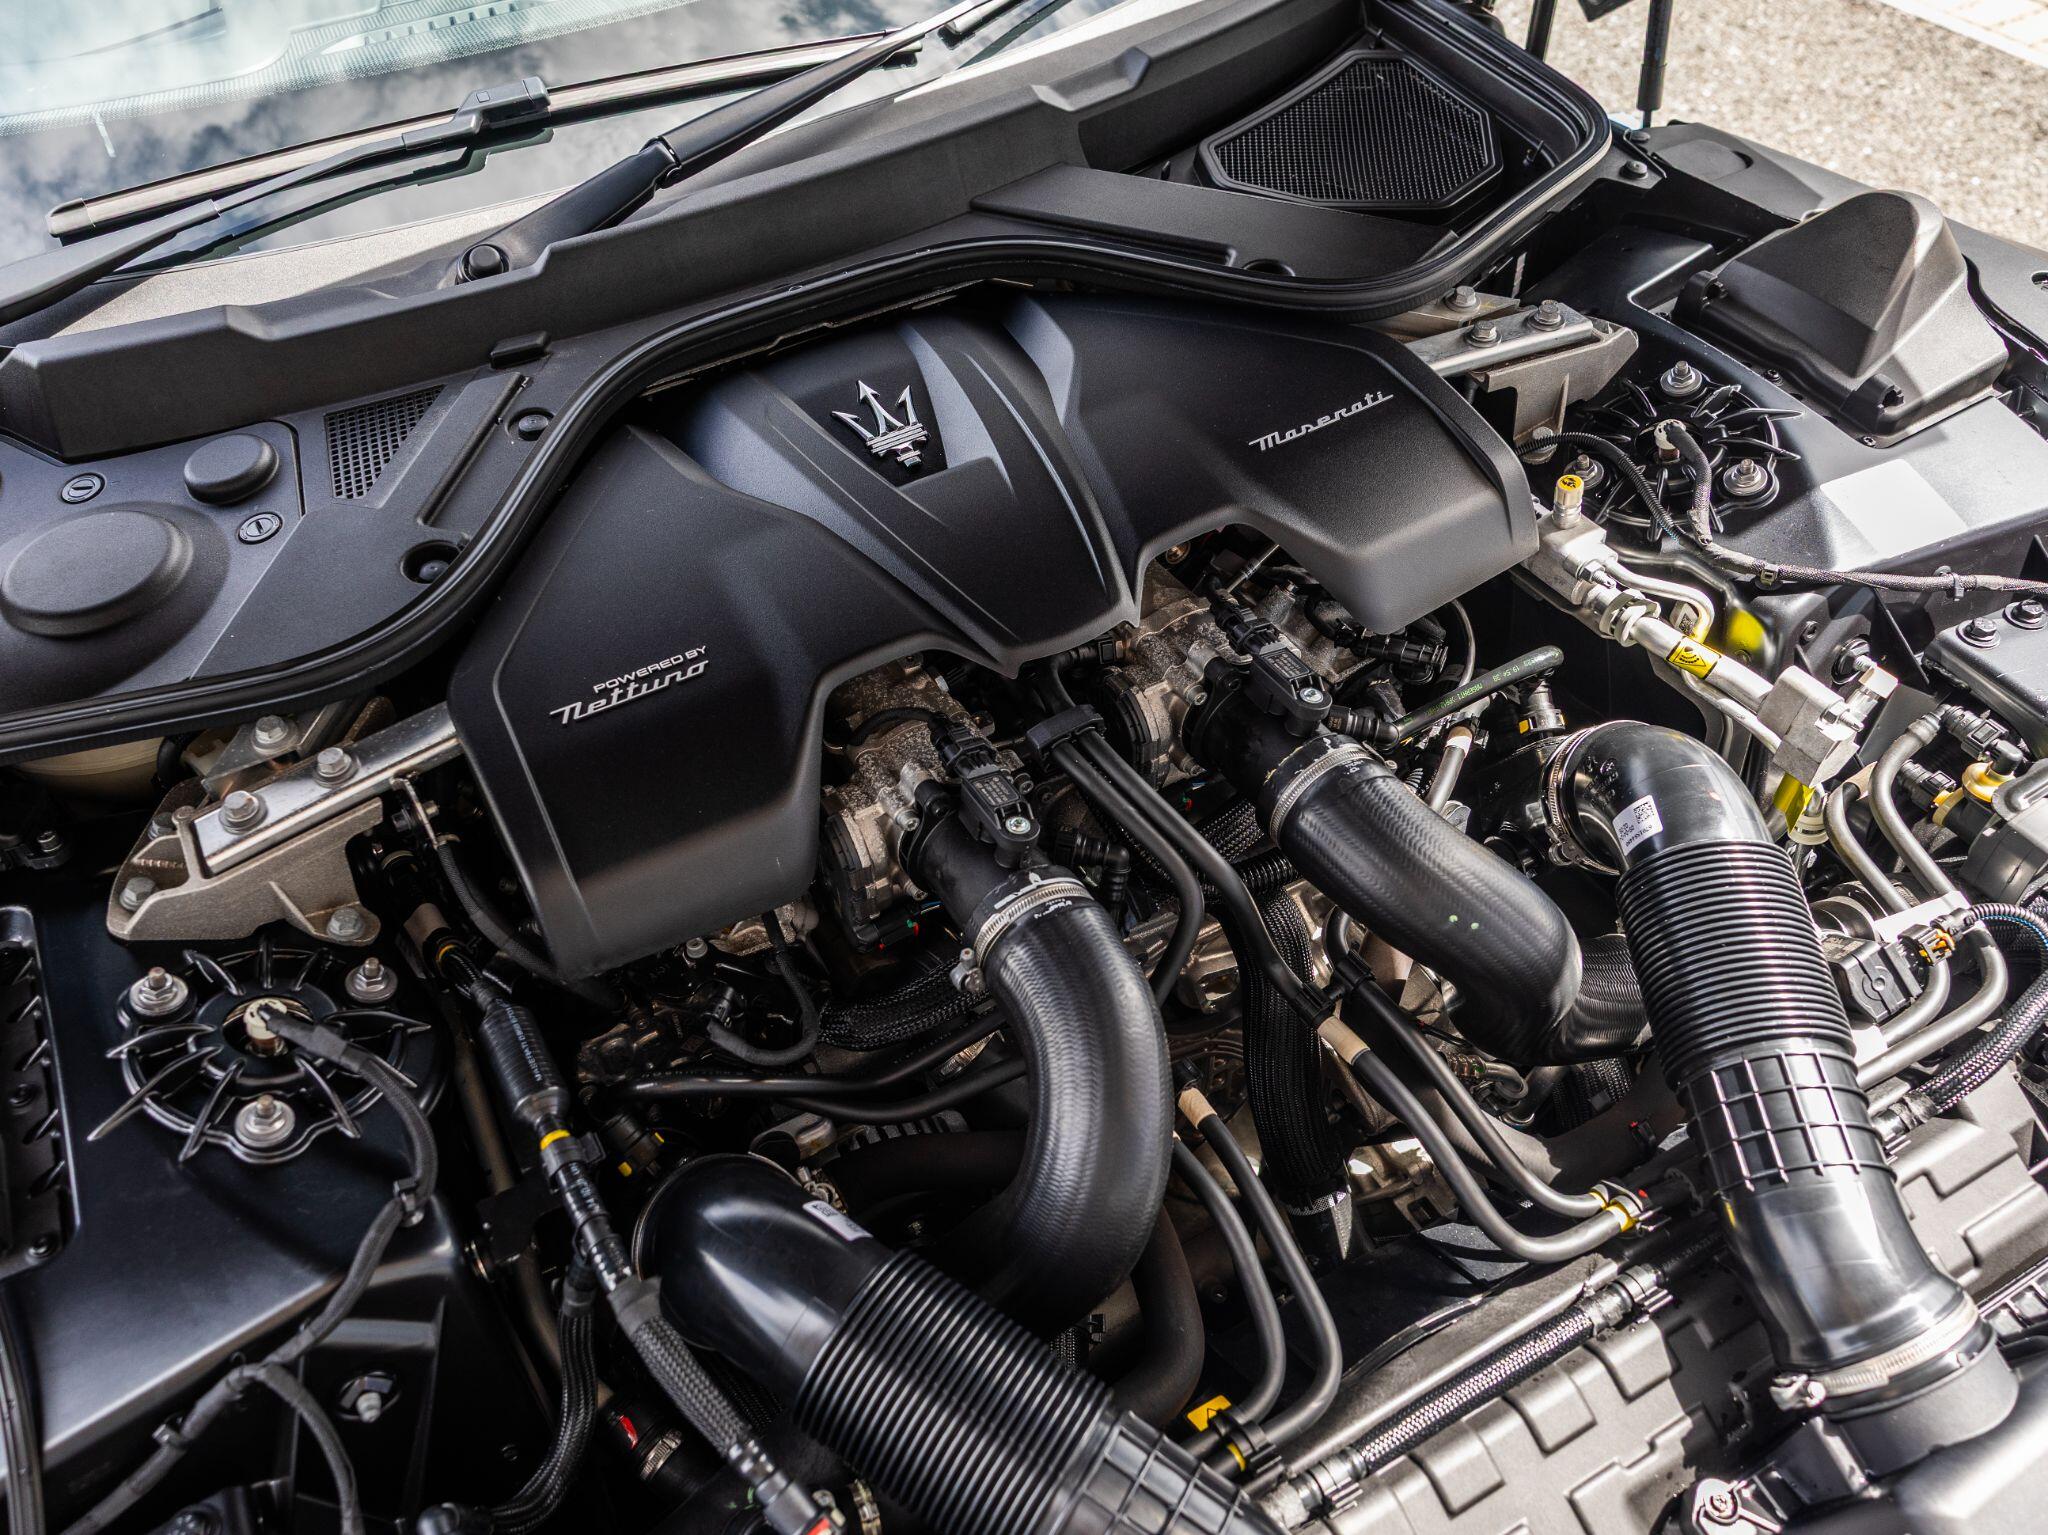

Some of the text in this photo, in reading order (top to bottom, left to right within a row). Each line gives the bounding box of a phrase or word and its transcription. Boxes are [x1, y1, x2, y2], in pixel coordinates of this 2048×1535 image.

[1248, 391, 1394, 451] Maserati
[549, 660, 709, 724] Nettuno
[593, 645, 706, 693] POWERED BY
[520, 1040, 542, 1082] MASERATI
